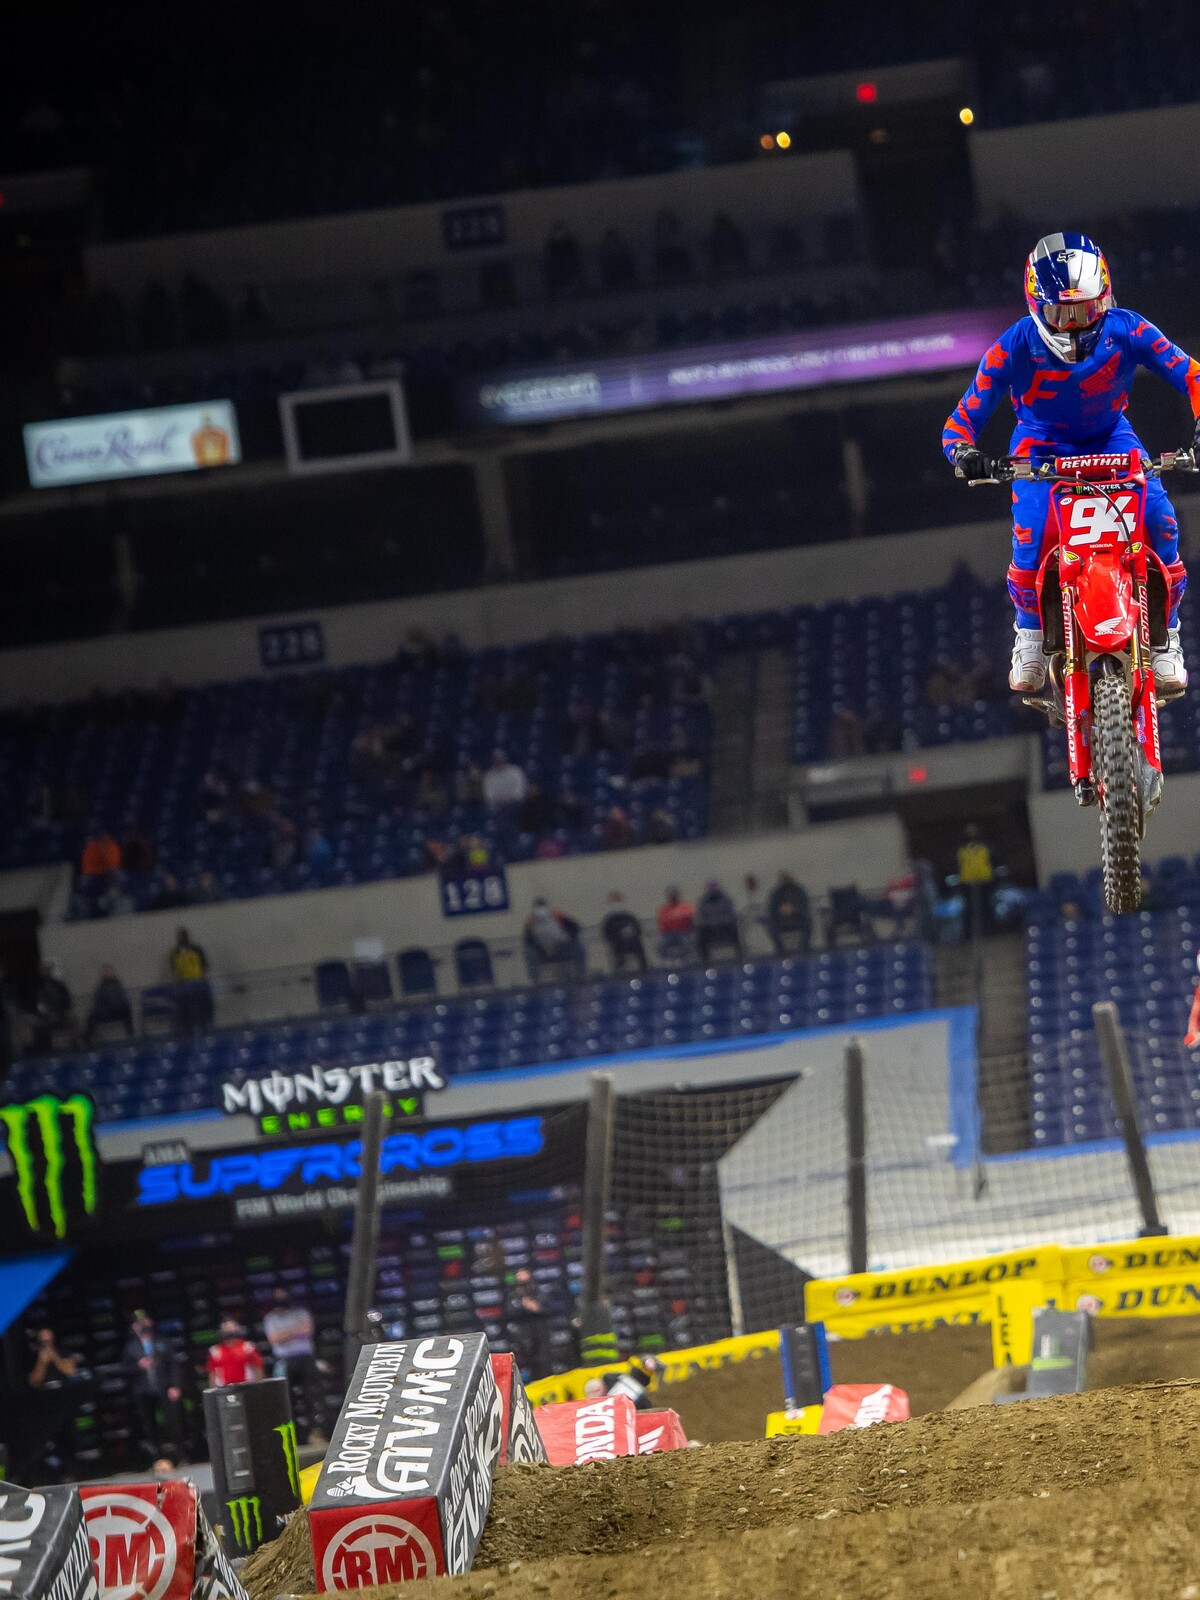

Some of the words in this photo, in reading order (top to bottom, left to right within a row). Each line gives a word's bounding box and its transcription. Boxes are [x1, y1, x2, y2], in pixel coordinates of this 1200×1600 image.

[1061, 458, 1129, 469] RENTHAL
[1068, 496, 1136, 546] 94
[222, 1057, 444, 1115] MONSTER
[872, 1257, 1037, 1299] DUNLOP
[344, 1343, 408, 1420] MOUNTAIN
[327, 1424, 381, 1474] ROCKY
[344, 1543, 415, 1588] RM
